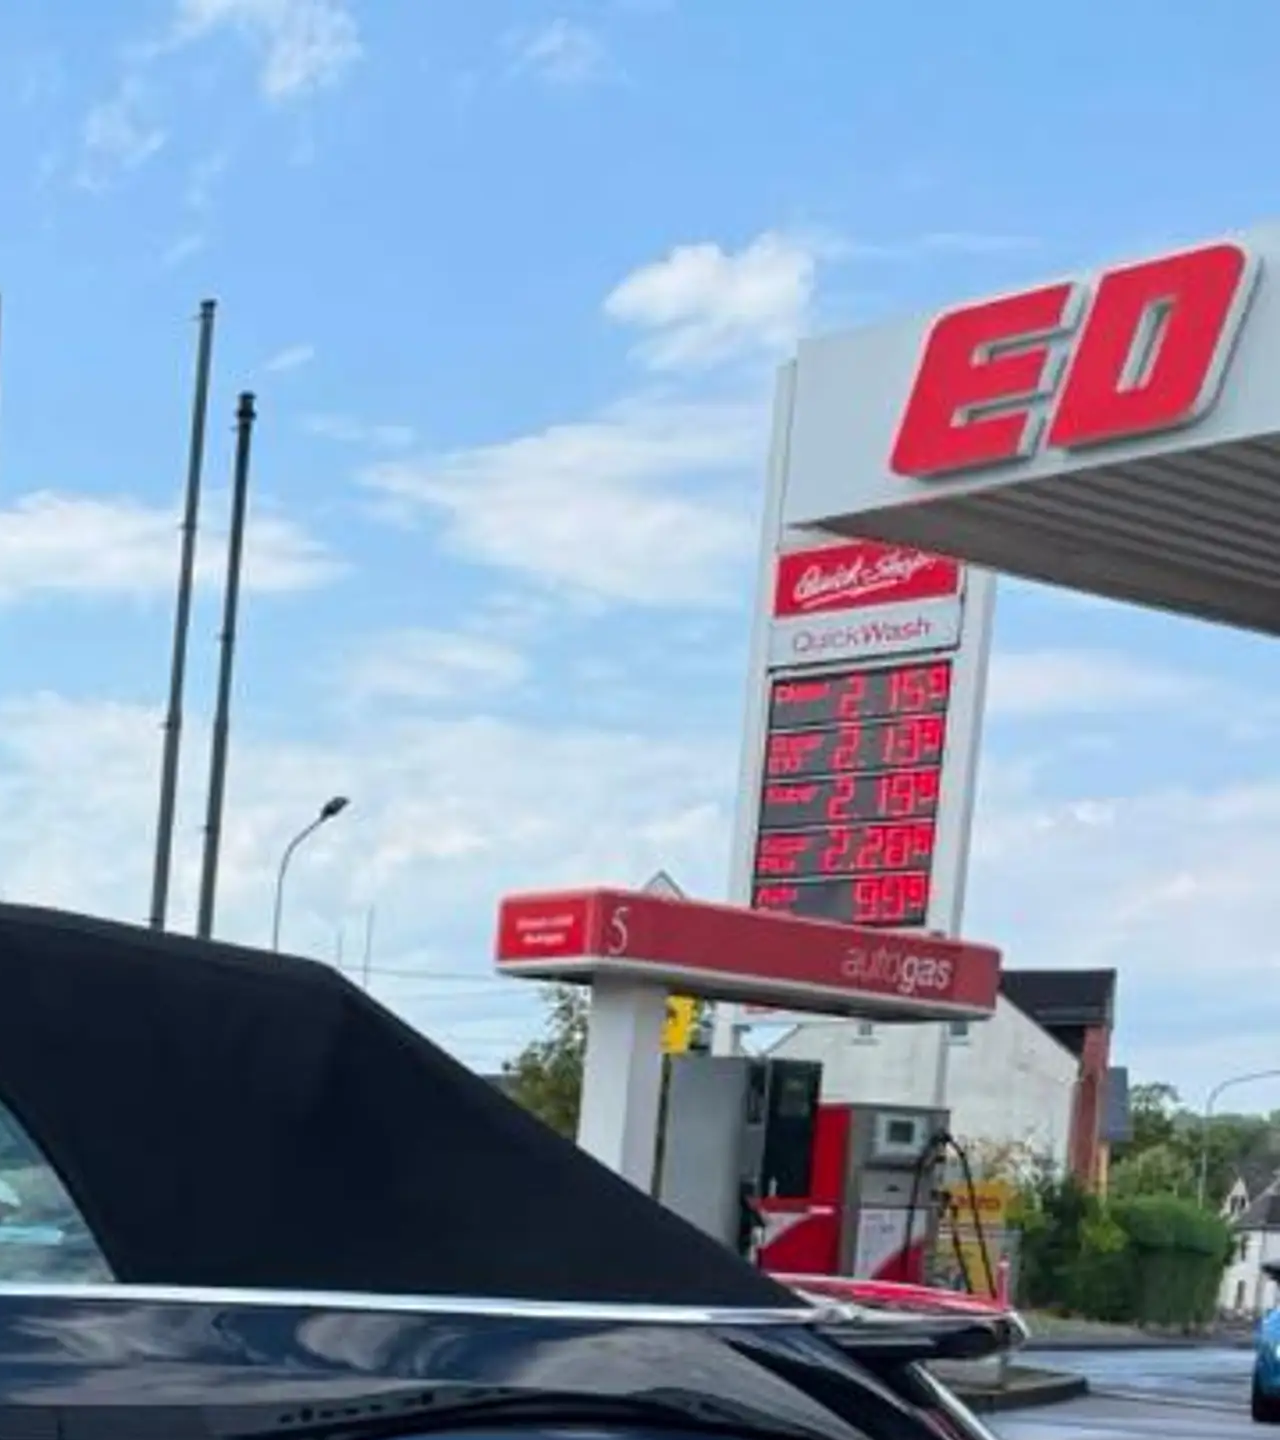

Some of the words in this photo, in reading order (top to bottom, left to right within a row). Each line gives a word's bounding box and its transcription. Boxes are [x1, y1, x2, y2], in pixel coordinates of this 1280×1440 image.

[889, 243, 1248, 478] ED
[607, 906, 629, 955] 5
[842, 946, 953, 994] autogas
